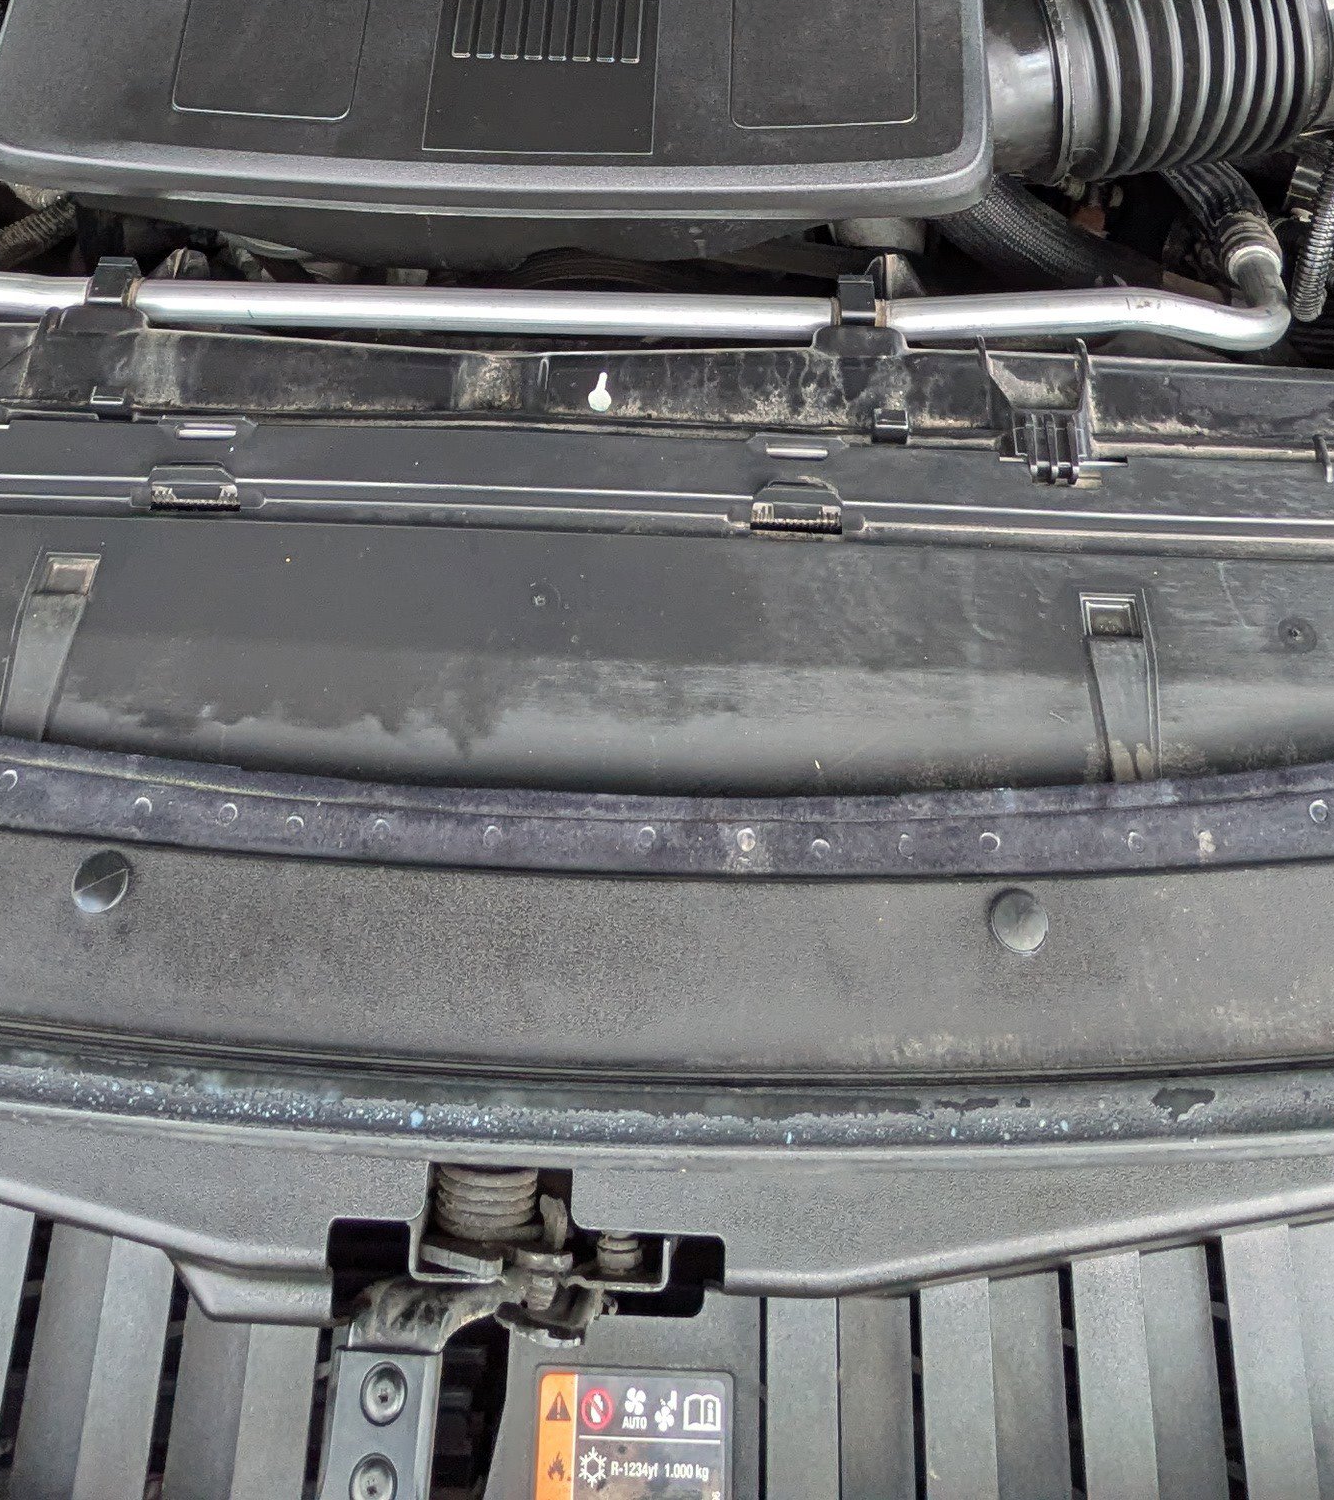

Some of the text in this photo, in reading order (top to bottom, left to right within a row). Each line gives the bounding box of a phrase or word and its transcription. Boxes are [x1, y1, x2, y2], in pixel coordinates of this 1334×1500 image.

[622, 1416, 648, 1430] AUTO
[610, 1460, 710, 1482] R-1234yf 1.000 kg
